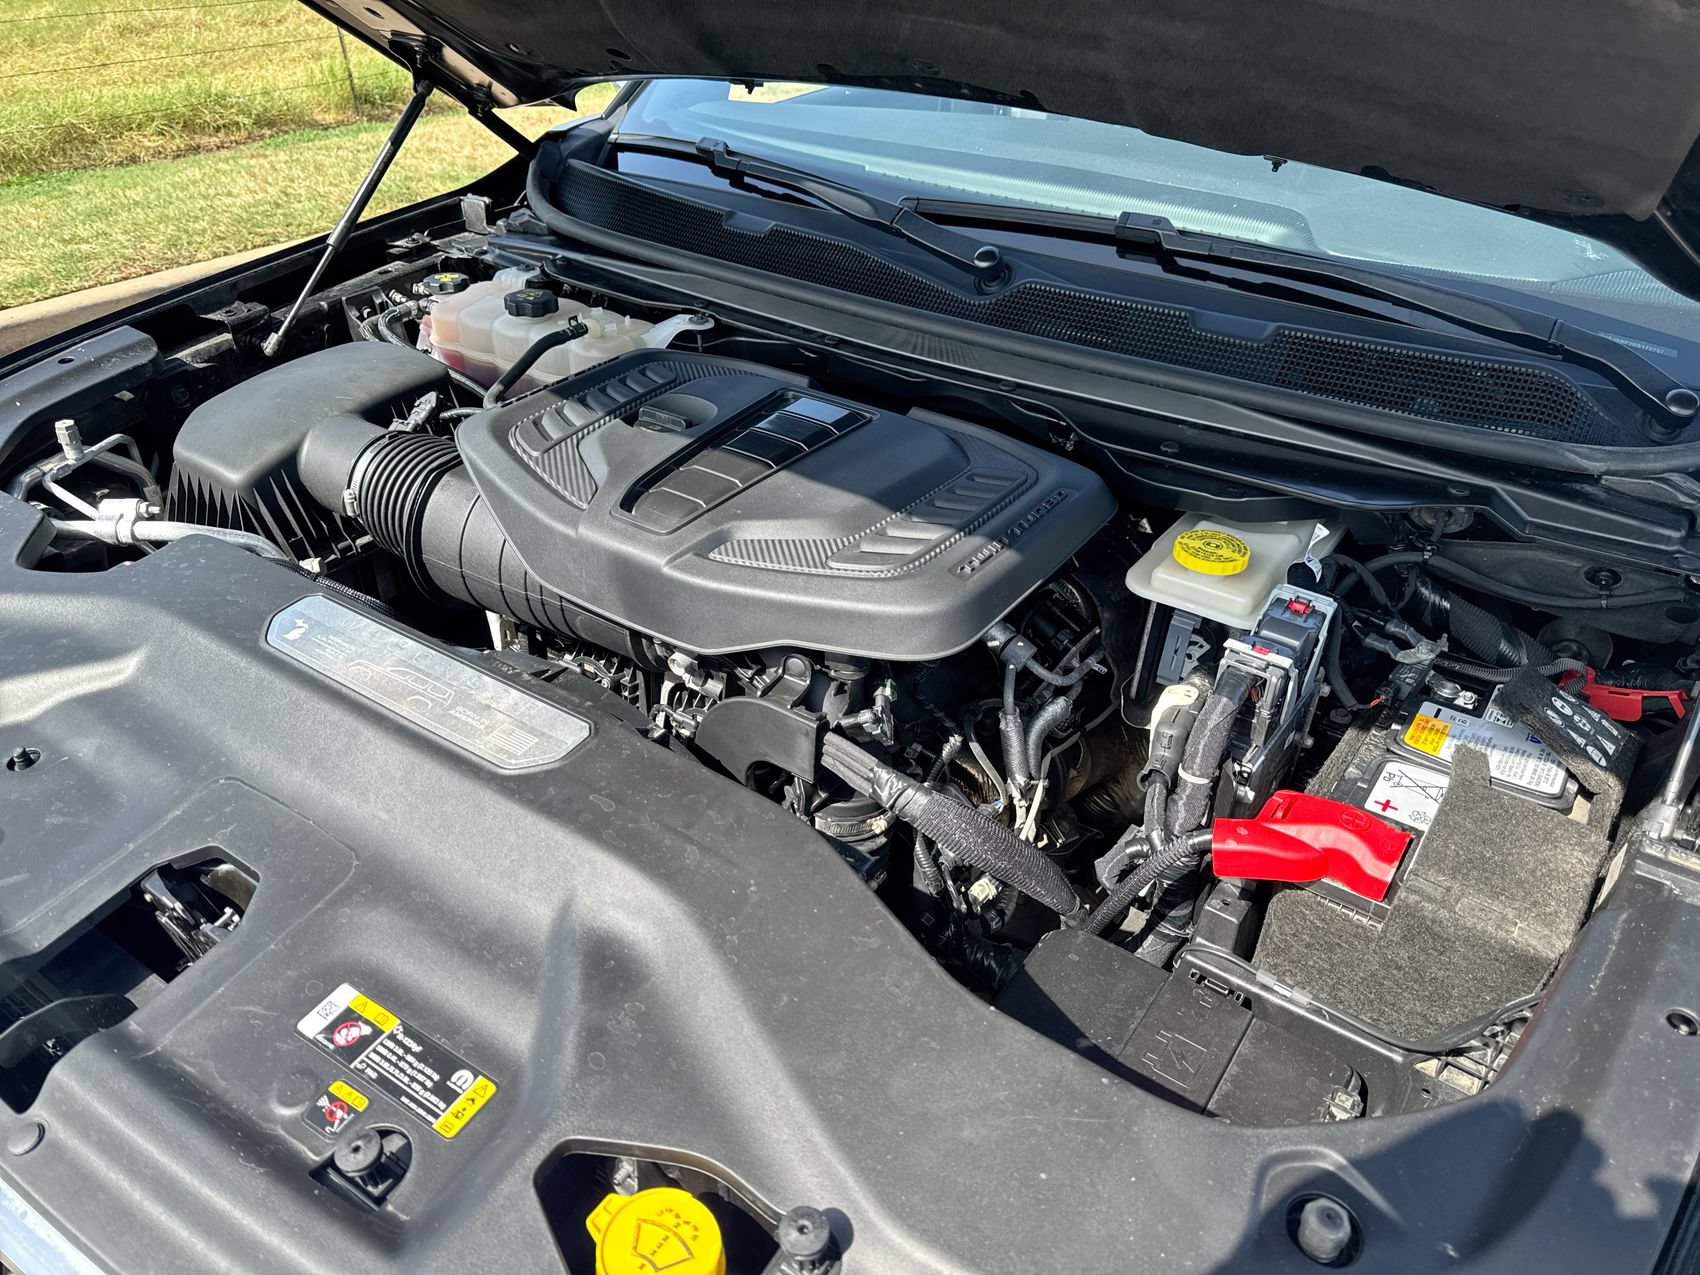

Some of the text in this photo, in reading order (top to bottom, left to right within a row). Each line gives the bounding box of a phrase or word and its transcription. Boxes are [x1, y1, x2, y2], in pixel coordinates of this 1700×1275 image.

[1007, 489, 1068, 536] TURBO
[448, 710, 485, 730] AMERICA
[455, 706, 480, 720] BORN
[1383, 771, 1396, 781] Pb
